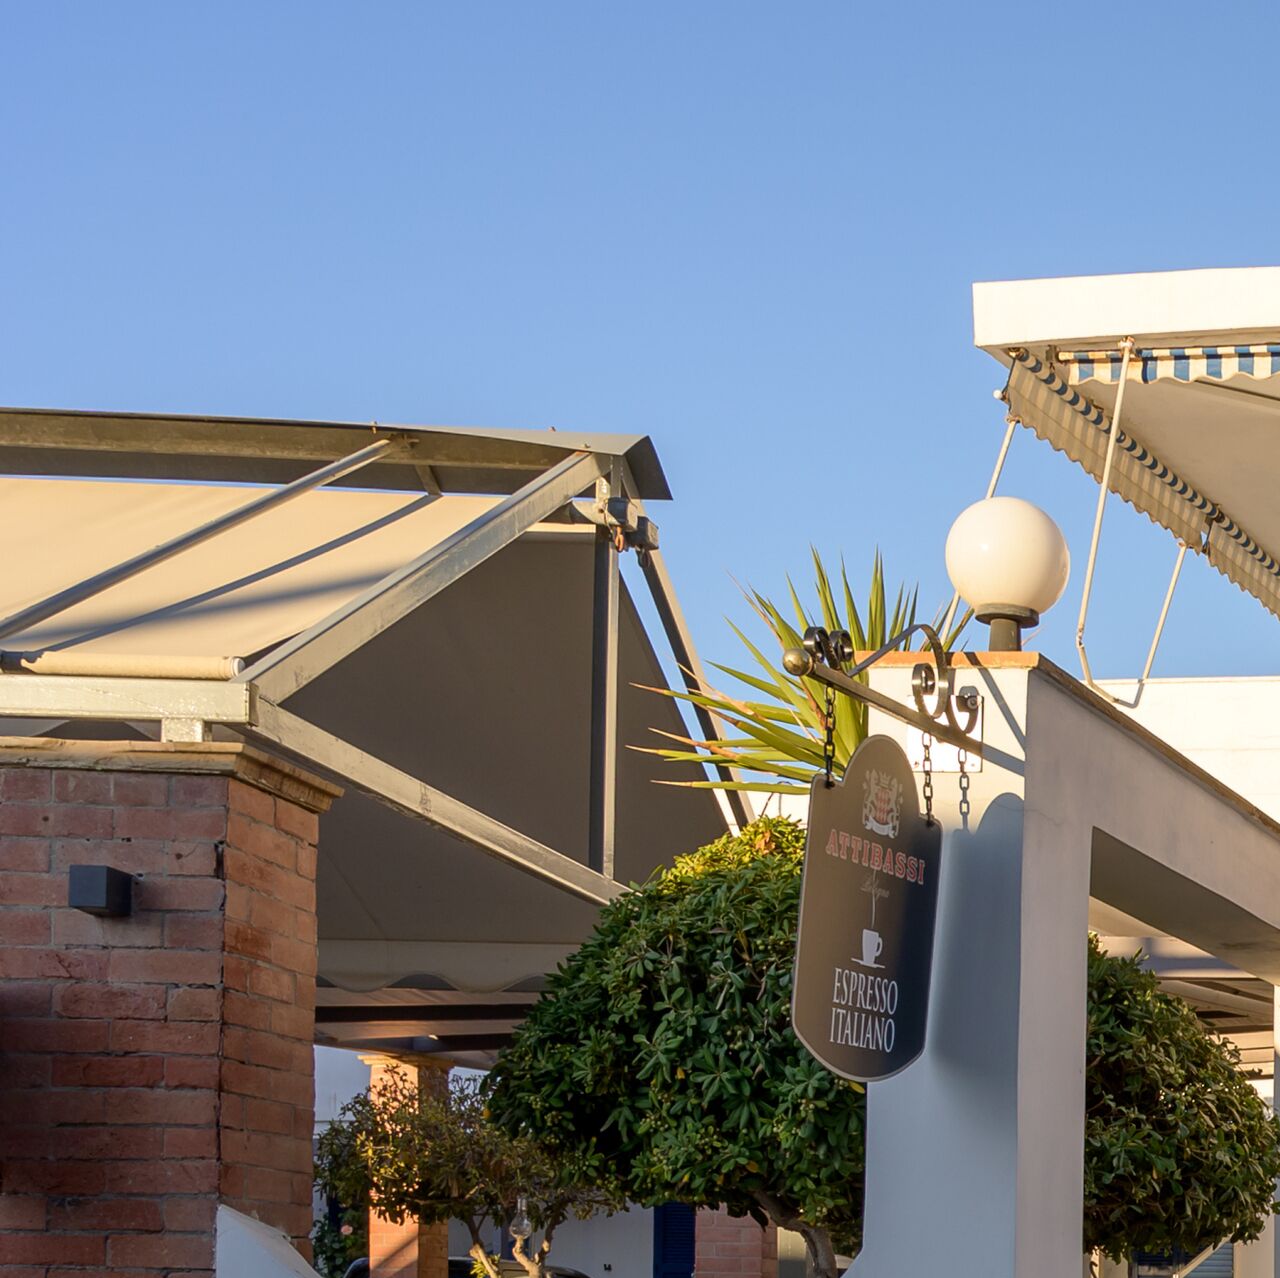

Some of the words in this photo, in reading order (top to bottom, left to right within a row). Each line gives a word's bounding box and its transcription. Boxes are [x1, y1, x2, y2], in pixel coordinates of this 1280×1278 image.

[825, 828, 925, 885] ATTIBASSI
[832, 967, 898, 1015] ESPRESSO
[829, 1007, 895, 1053] ITALIANO
